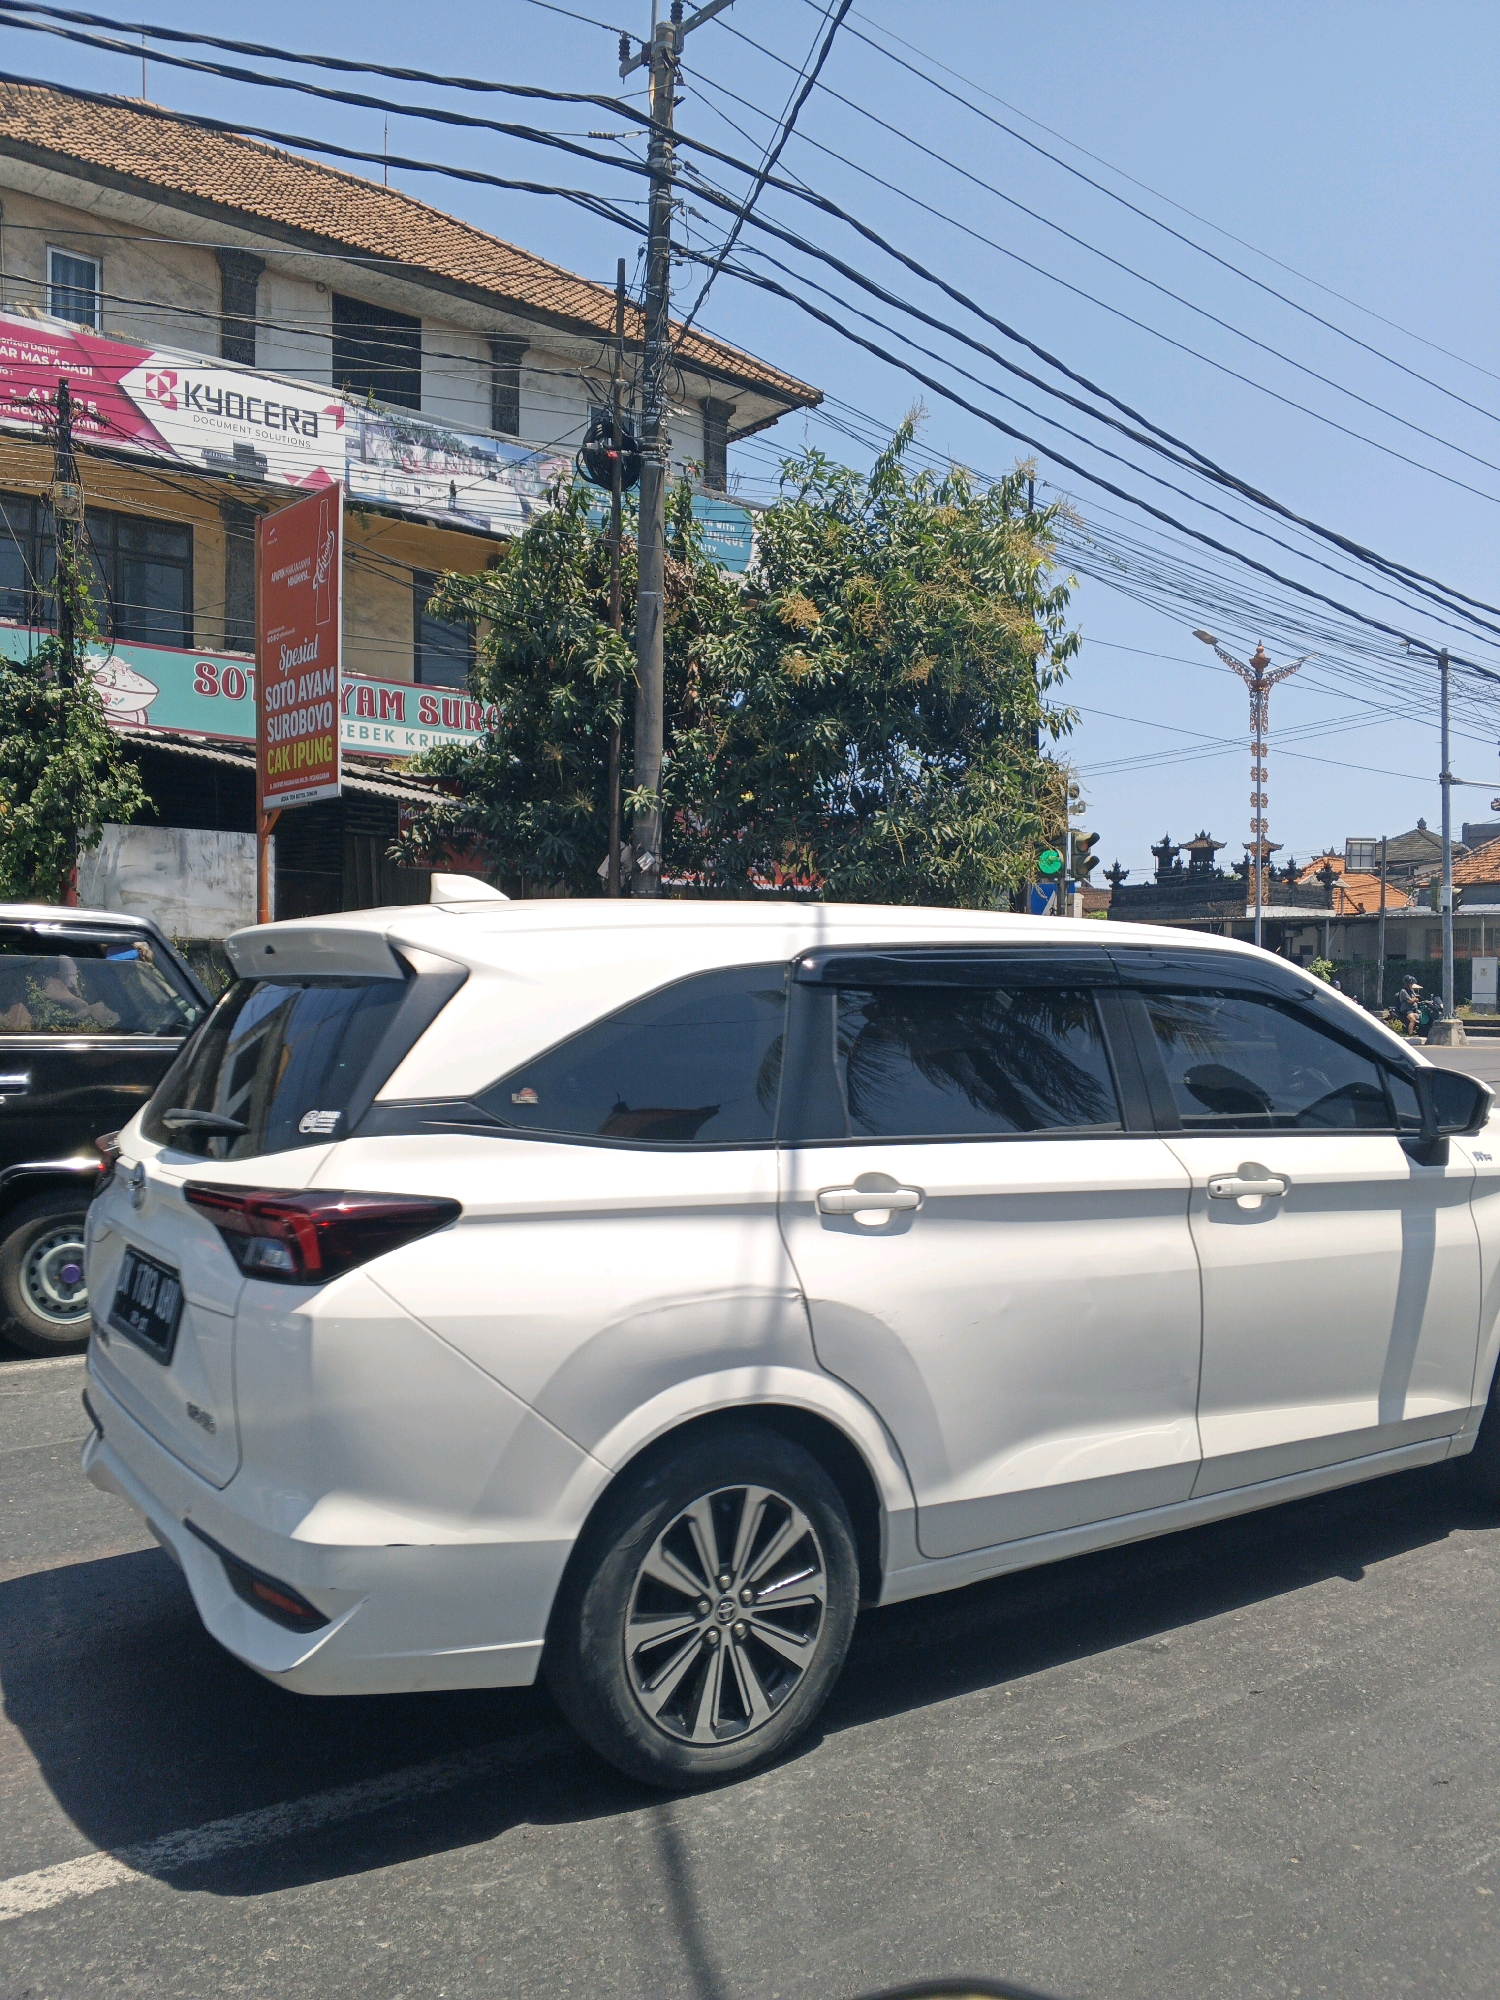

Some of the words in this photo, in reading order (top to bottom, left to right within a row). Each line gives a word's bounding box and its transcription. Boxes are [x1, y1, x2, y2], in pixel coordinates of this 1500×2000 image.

[21, 351, 49, 365] MAS
[53, 359, 93, 376] ABADI
[193, 414, 252, 434] DOCUMENT
[255, 430, 311, 447] SOLUTIONS
[707, 531, 744, 548] UNIQUE
[279, 633, 319, 677] Spesial
[265, 678, 295, 712] SOTO
[298, 666, 335, 702] AYAM
[341, 682, 406, 722] YAM
[267, 701, 332, 743] SUROBOYO
[267, 744, 291, 775] CAK
[293, 735, 333, 769] IPUNG
